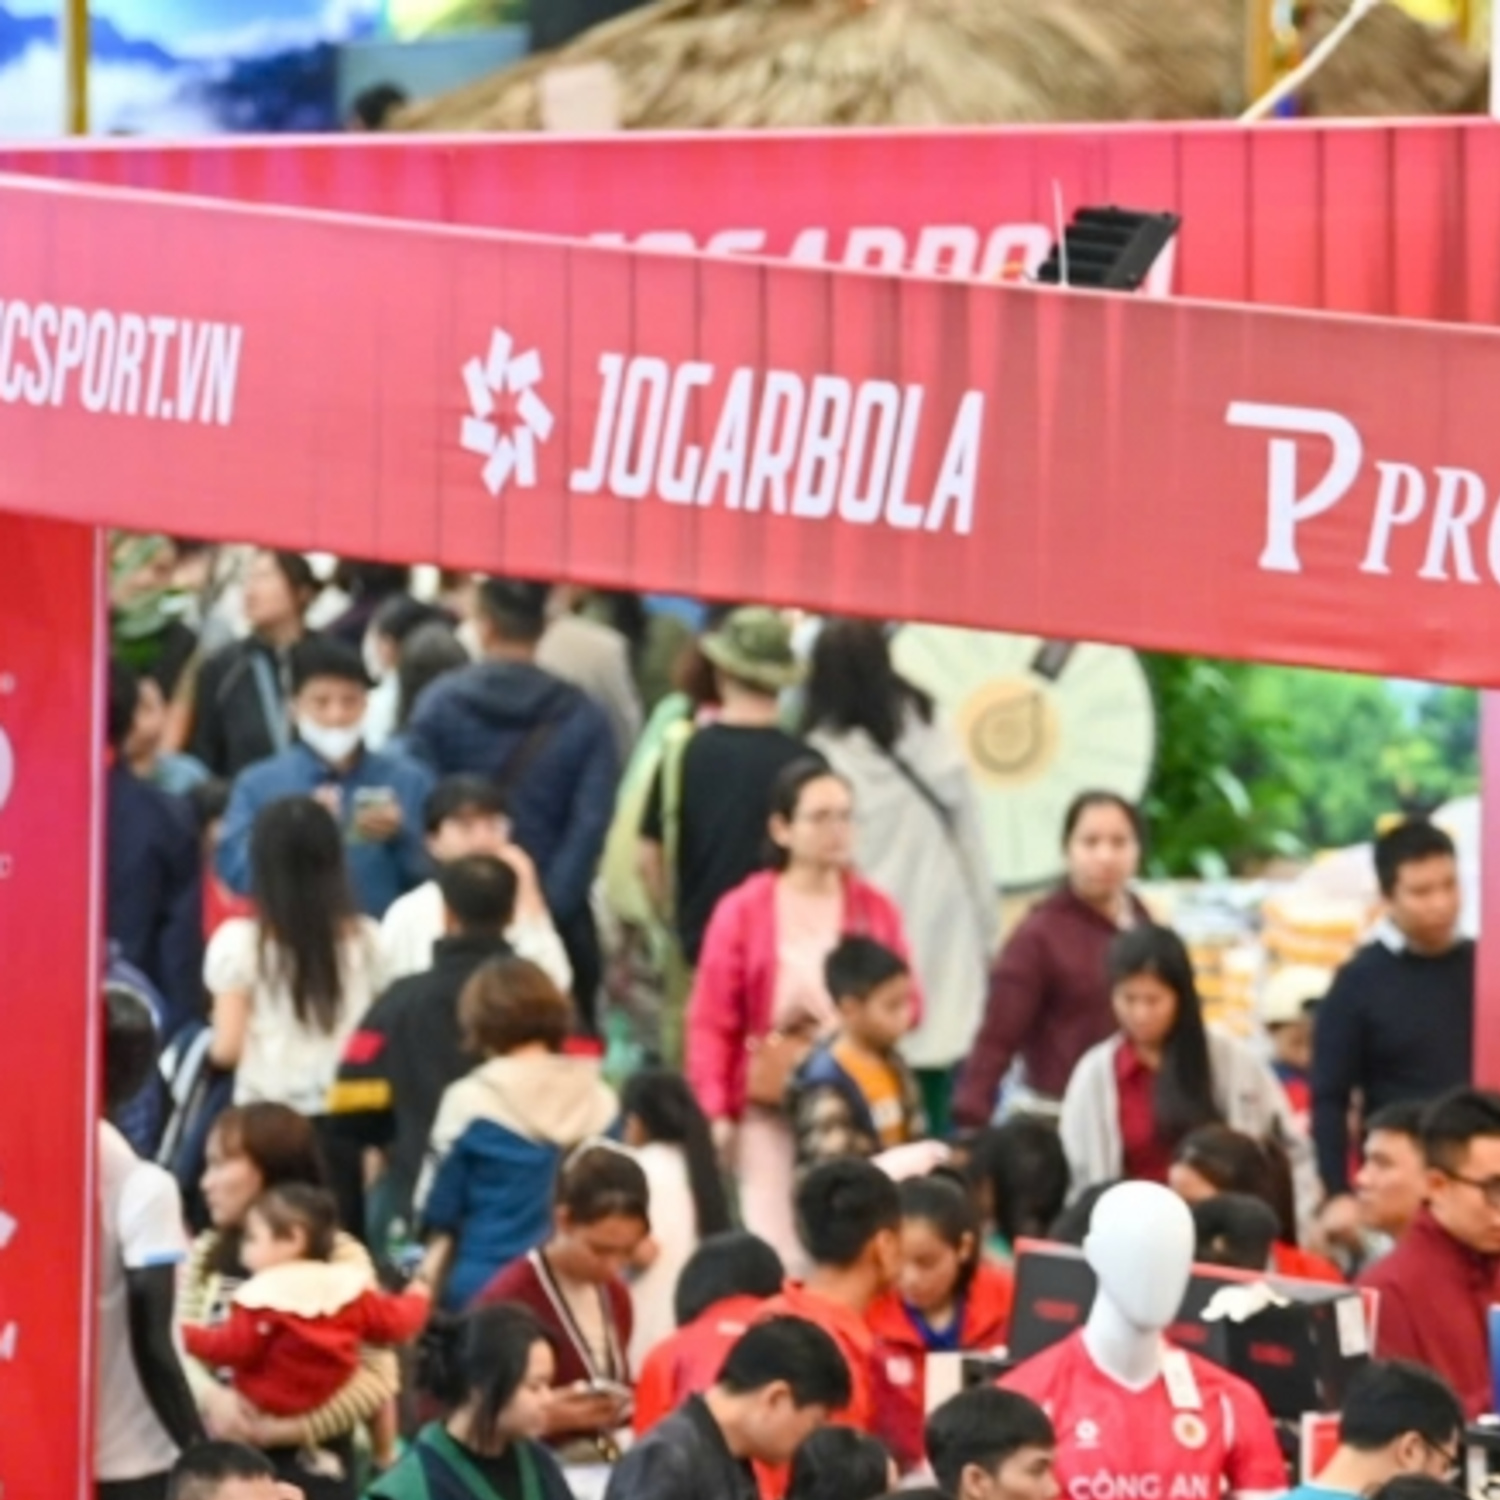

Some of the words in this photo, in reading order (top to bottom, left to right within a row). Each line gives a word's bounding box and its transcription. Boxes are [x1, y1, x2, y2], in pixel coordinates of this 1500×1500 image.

[0, 298, 242, 426] CSPORT.VN
[569, 353, 985, 535] JOGARBOLA
[1170, 1474, 1210, 1500] AN
